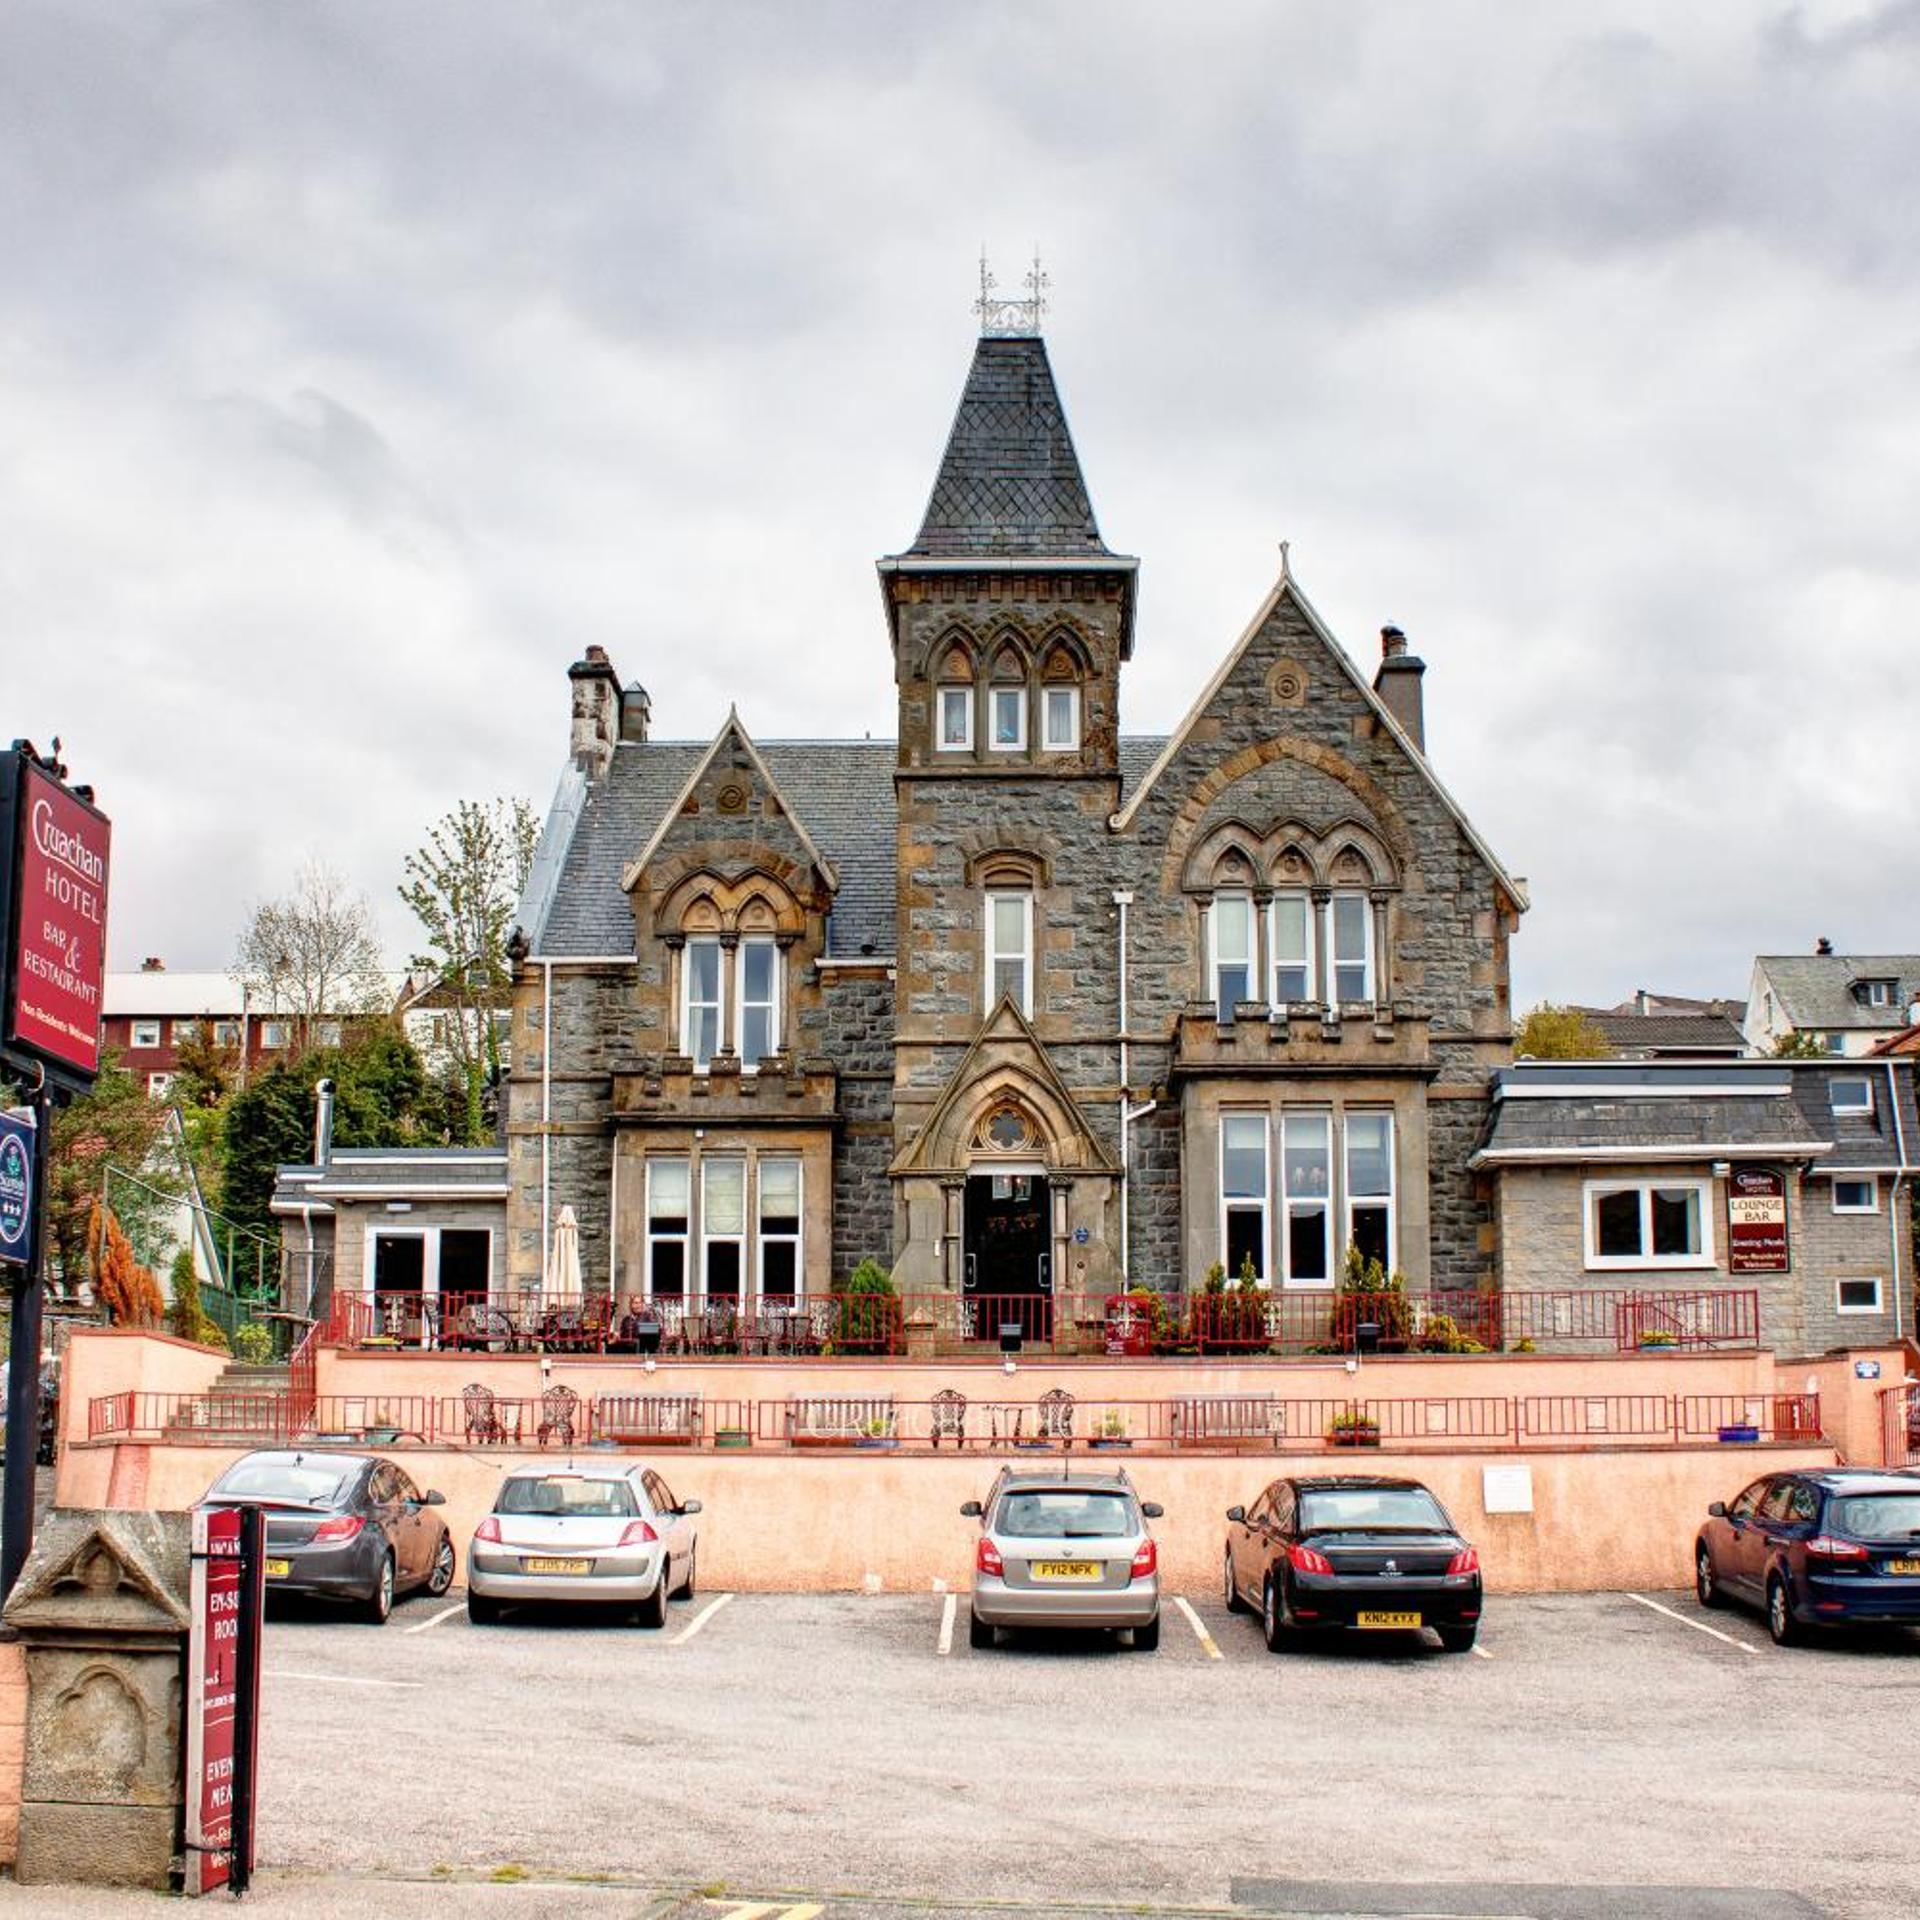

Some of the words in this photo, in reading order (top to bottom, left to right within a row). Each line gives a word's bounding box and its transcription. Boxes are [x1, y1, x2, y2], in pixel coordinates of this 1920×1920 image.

[32, 799, 103, 882] Cruachan
[45, 866, 101, 924] HOTEL
[43, 921, 66, 950] BAR
[65, 936, 80, 972] &
[24, 948, 97, 1005] RESTAURANT
[1731, 1199, 1782, 1210] LOUNGE
[1744, 1211, 1771, 1222] BAR
[1041, 1564, 1068, 1575] FY12
[214, 1618, 238, 1640] ROO
[206, 1757, 233, 1782] EVEN
[210, 1783, 232, 1809] MEA
